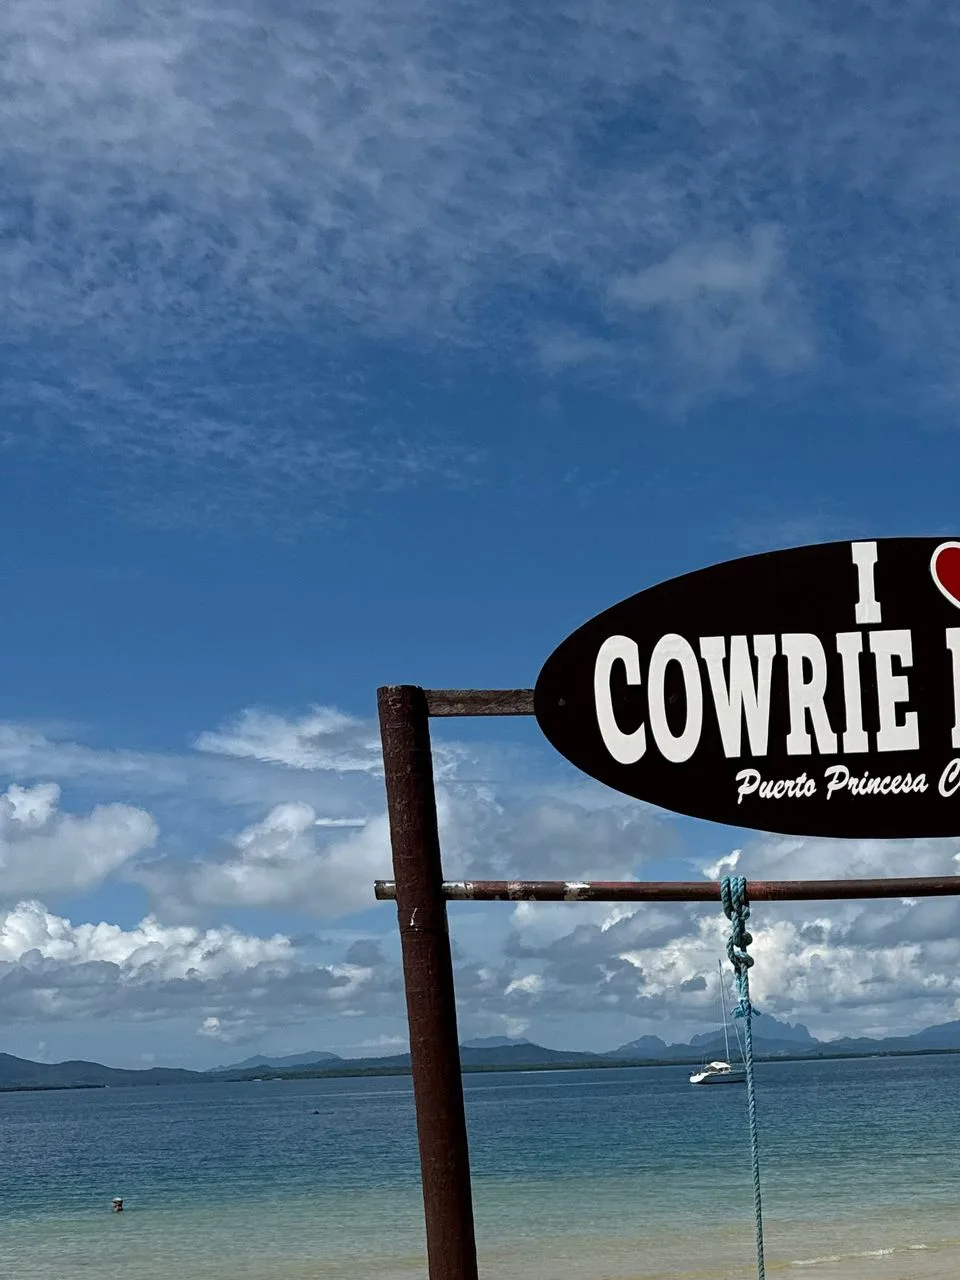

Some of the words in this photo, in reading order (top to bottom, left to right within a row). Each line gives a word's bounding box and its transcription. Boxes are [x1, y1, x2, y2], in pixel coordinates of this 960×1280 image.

[851, 541, 882, 625] I
[593, 629, 920, 765] COWRIE
[735, 768, 817, 805] Puerto
[823, 764, 929, 801] Princesa
